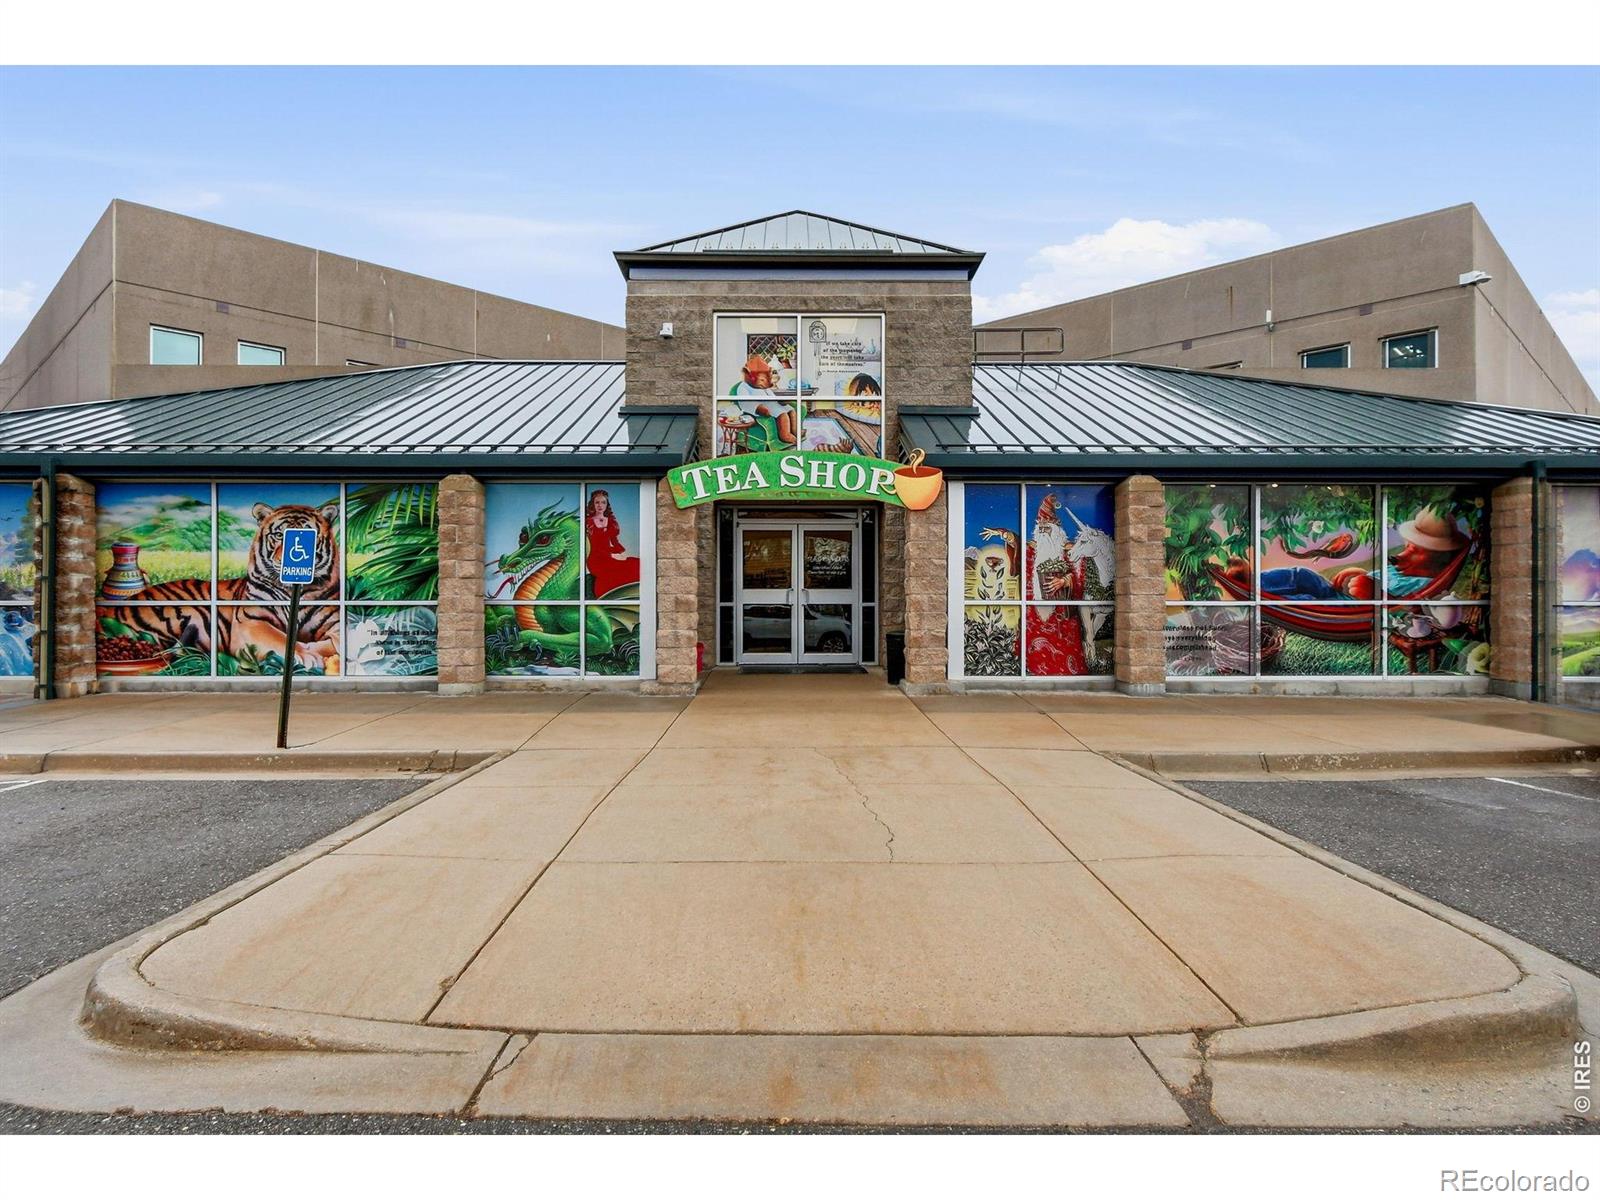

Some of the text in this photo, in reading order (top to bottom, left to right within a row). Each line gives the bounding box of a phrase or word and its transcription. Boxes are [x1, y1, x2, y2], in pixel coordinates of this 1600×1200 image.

[682, 455, 896, 500] TEA SHOP
[283, 566, 312, 576] PARKING
